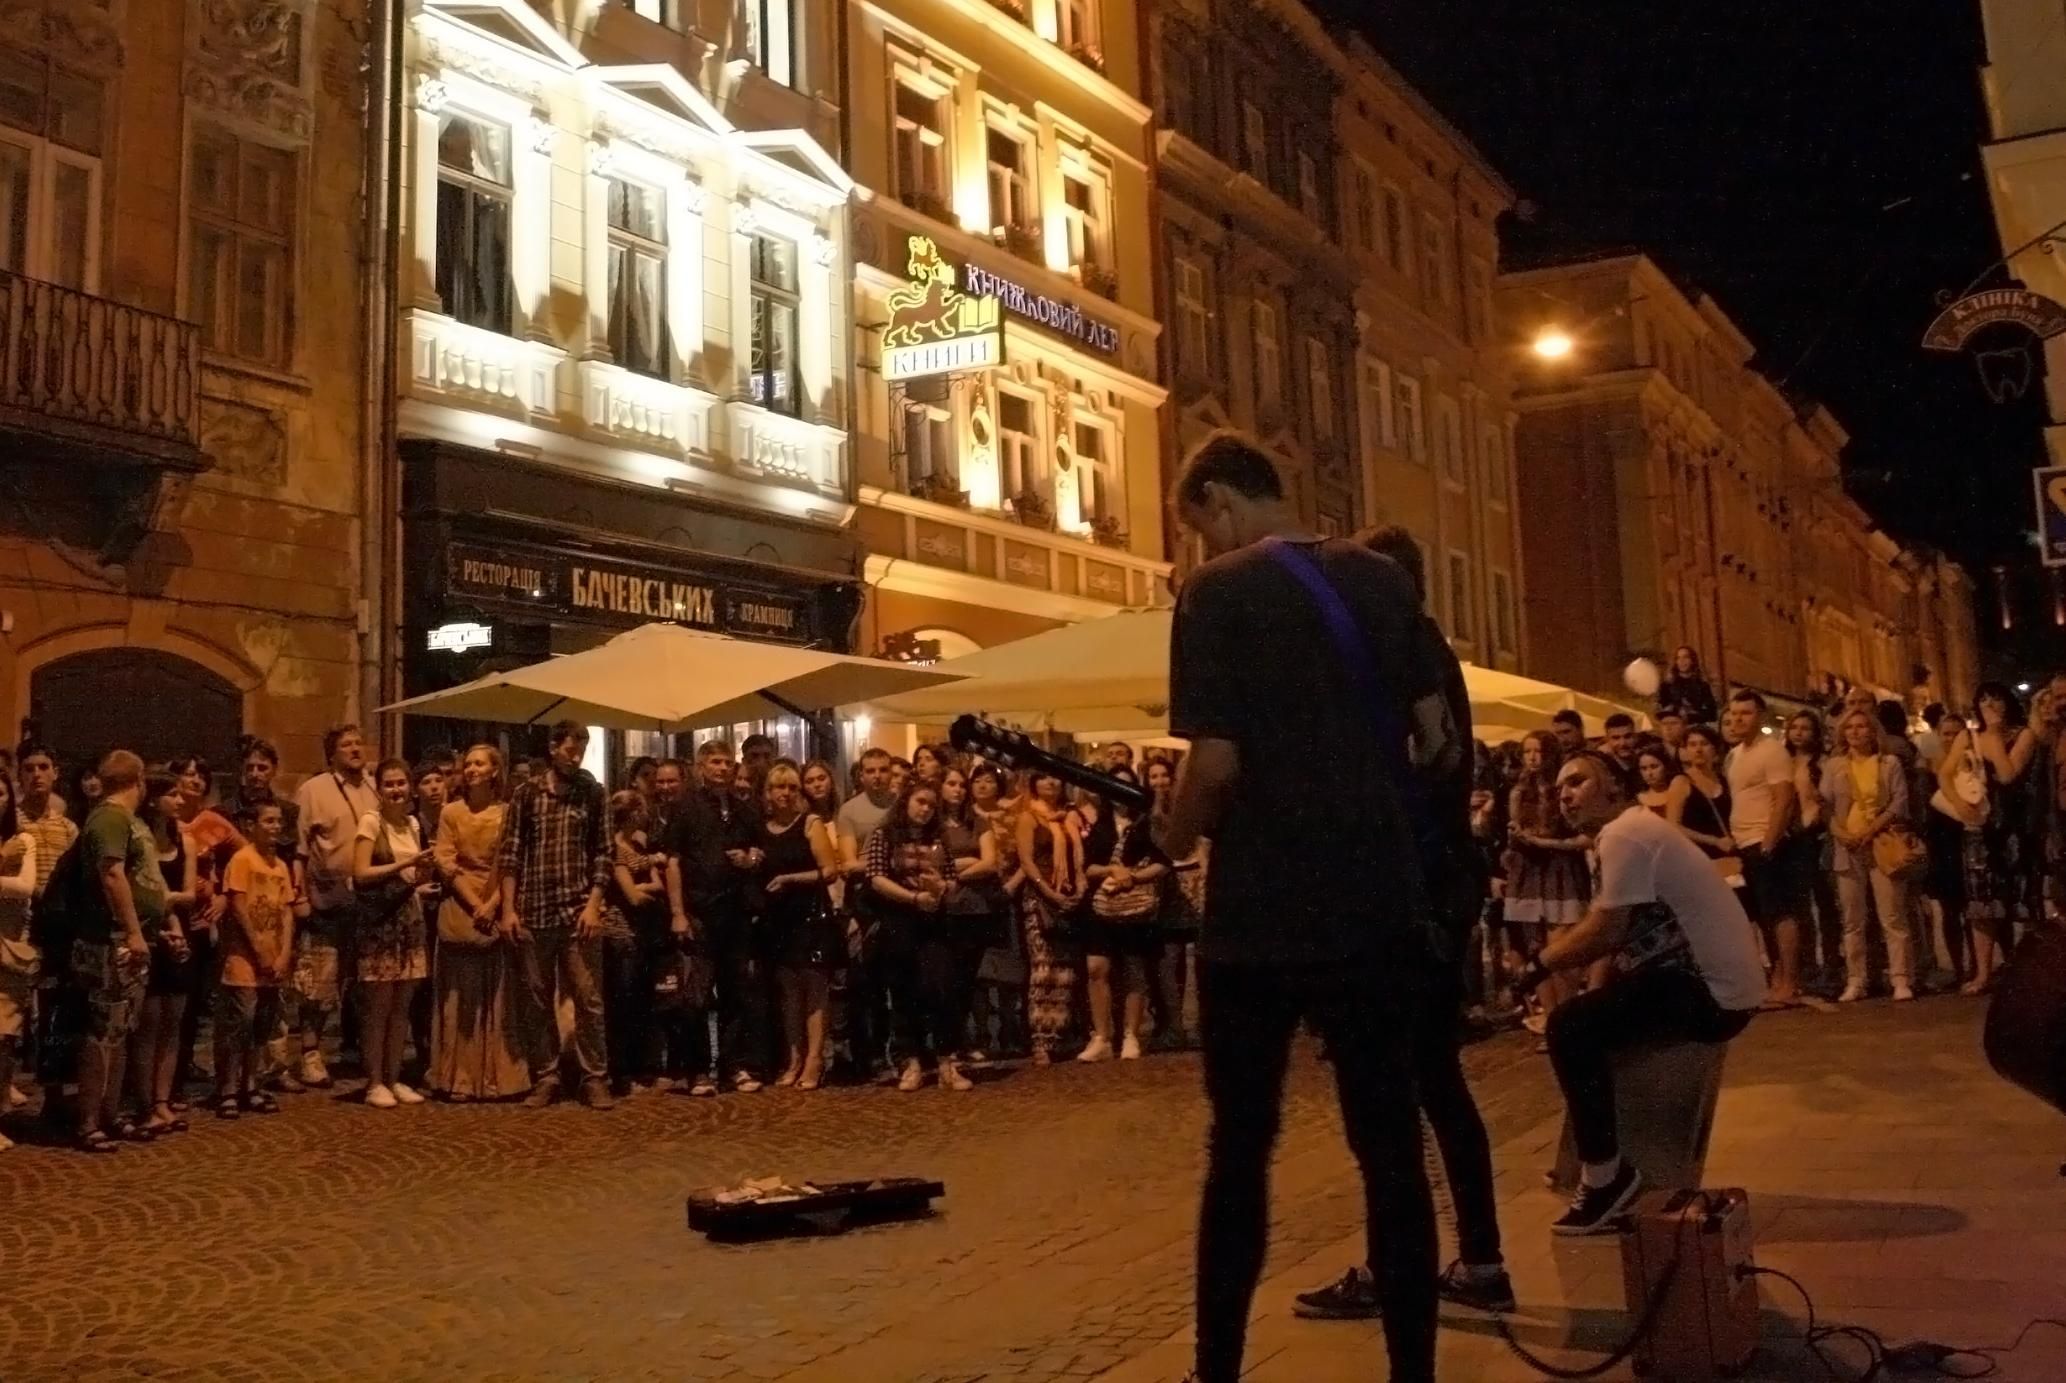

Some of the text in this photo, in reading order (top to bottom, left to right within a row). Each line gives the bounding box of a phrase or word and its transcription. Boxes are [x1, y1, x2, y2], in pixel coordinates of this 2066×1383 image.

[1952, 291, 2038, 320] КЛІНІКА
[894, 340, 987, 375] КНИГИ
[463, 559, 542, 593] РЕСТОРАЦІЯ
[572, 567, 714, 624] БАЧЕВСЬКИХ
